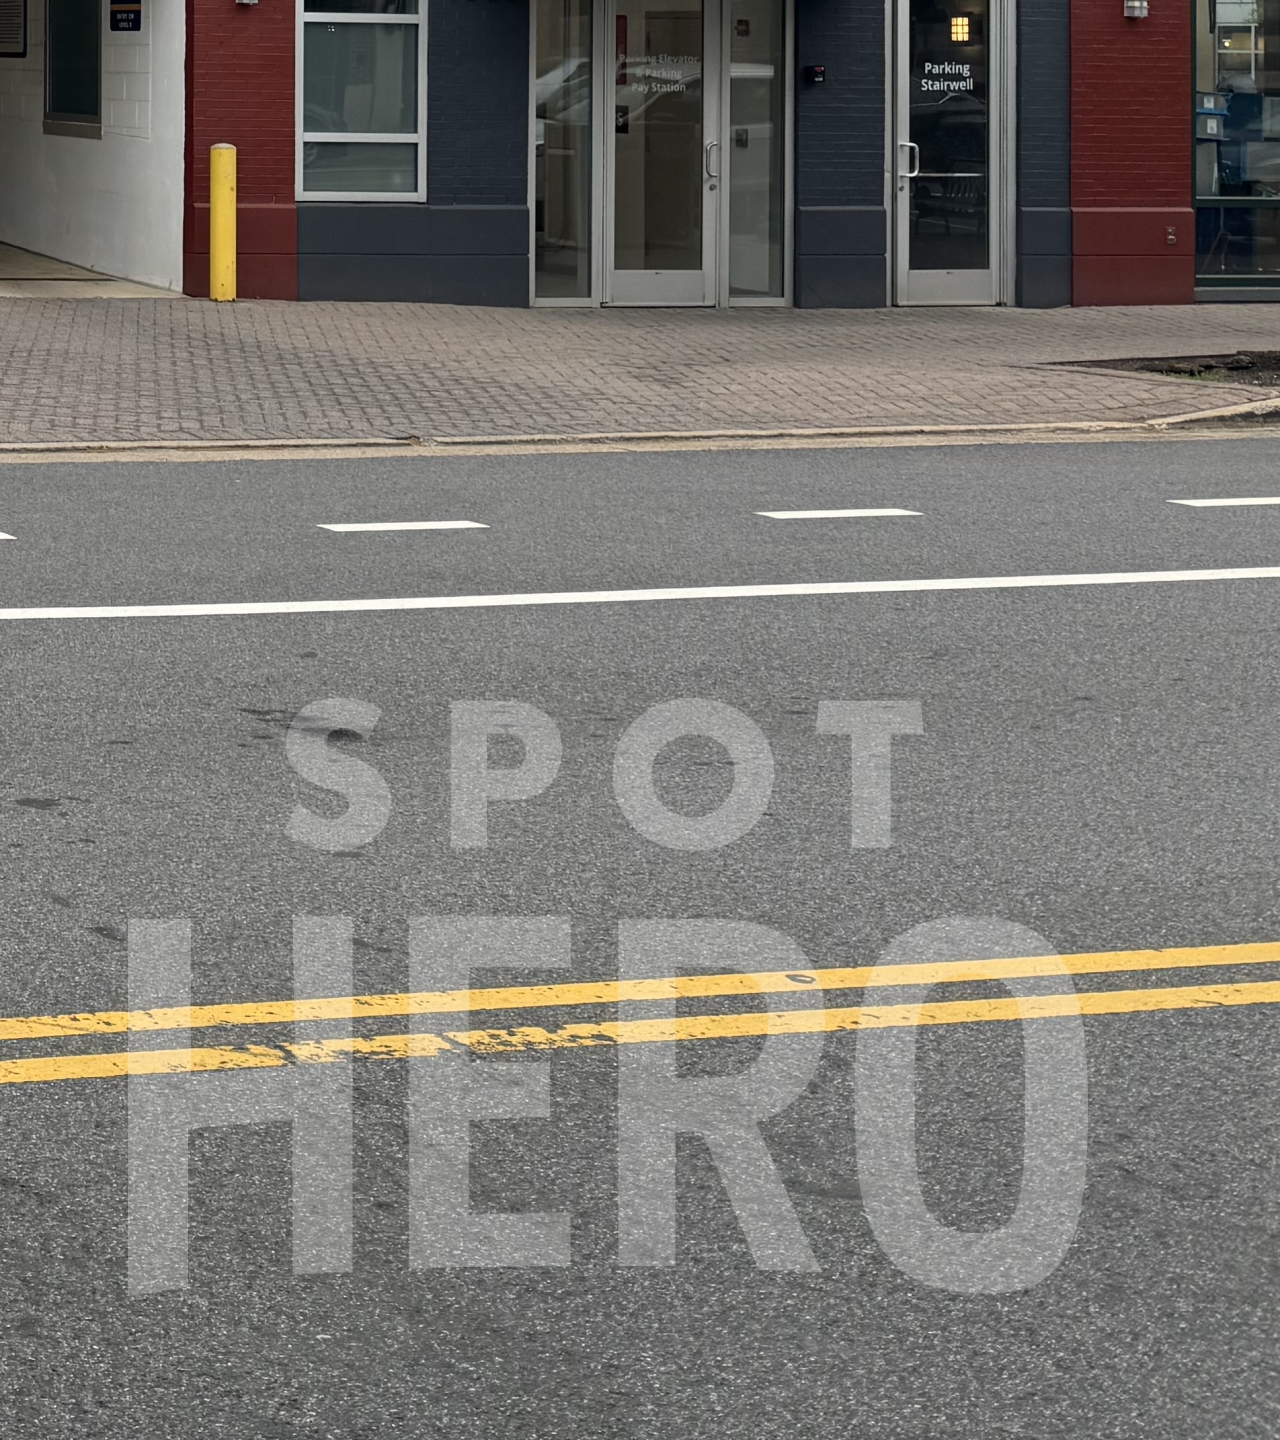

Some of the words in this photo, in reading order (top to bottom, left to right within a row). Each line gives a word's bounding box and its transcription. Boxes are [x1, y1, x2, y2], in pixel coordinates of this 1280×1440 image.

[619, 54, 656, 65] Parking
[659, 54, 699, 64] Elevator
[645, 68, 683, 80] Parking
[924, 61, 971, 77] Parking
[632, 83, 649, 94] Pay
[651, 82, 686, 92] Station
[920, 77, 974, 91] Stairwell
